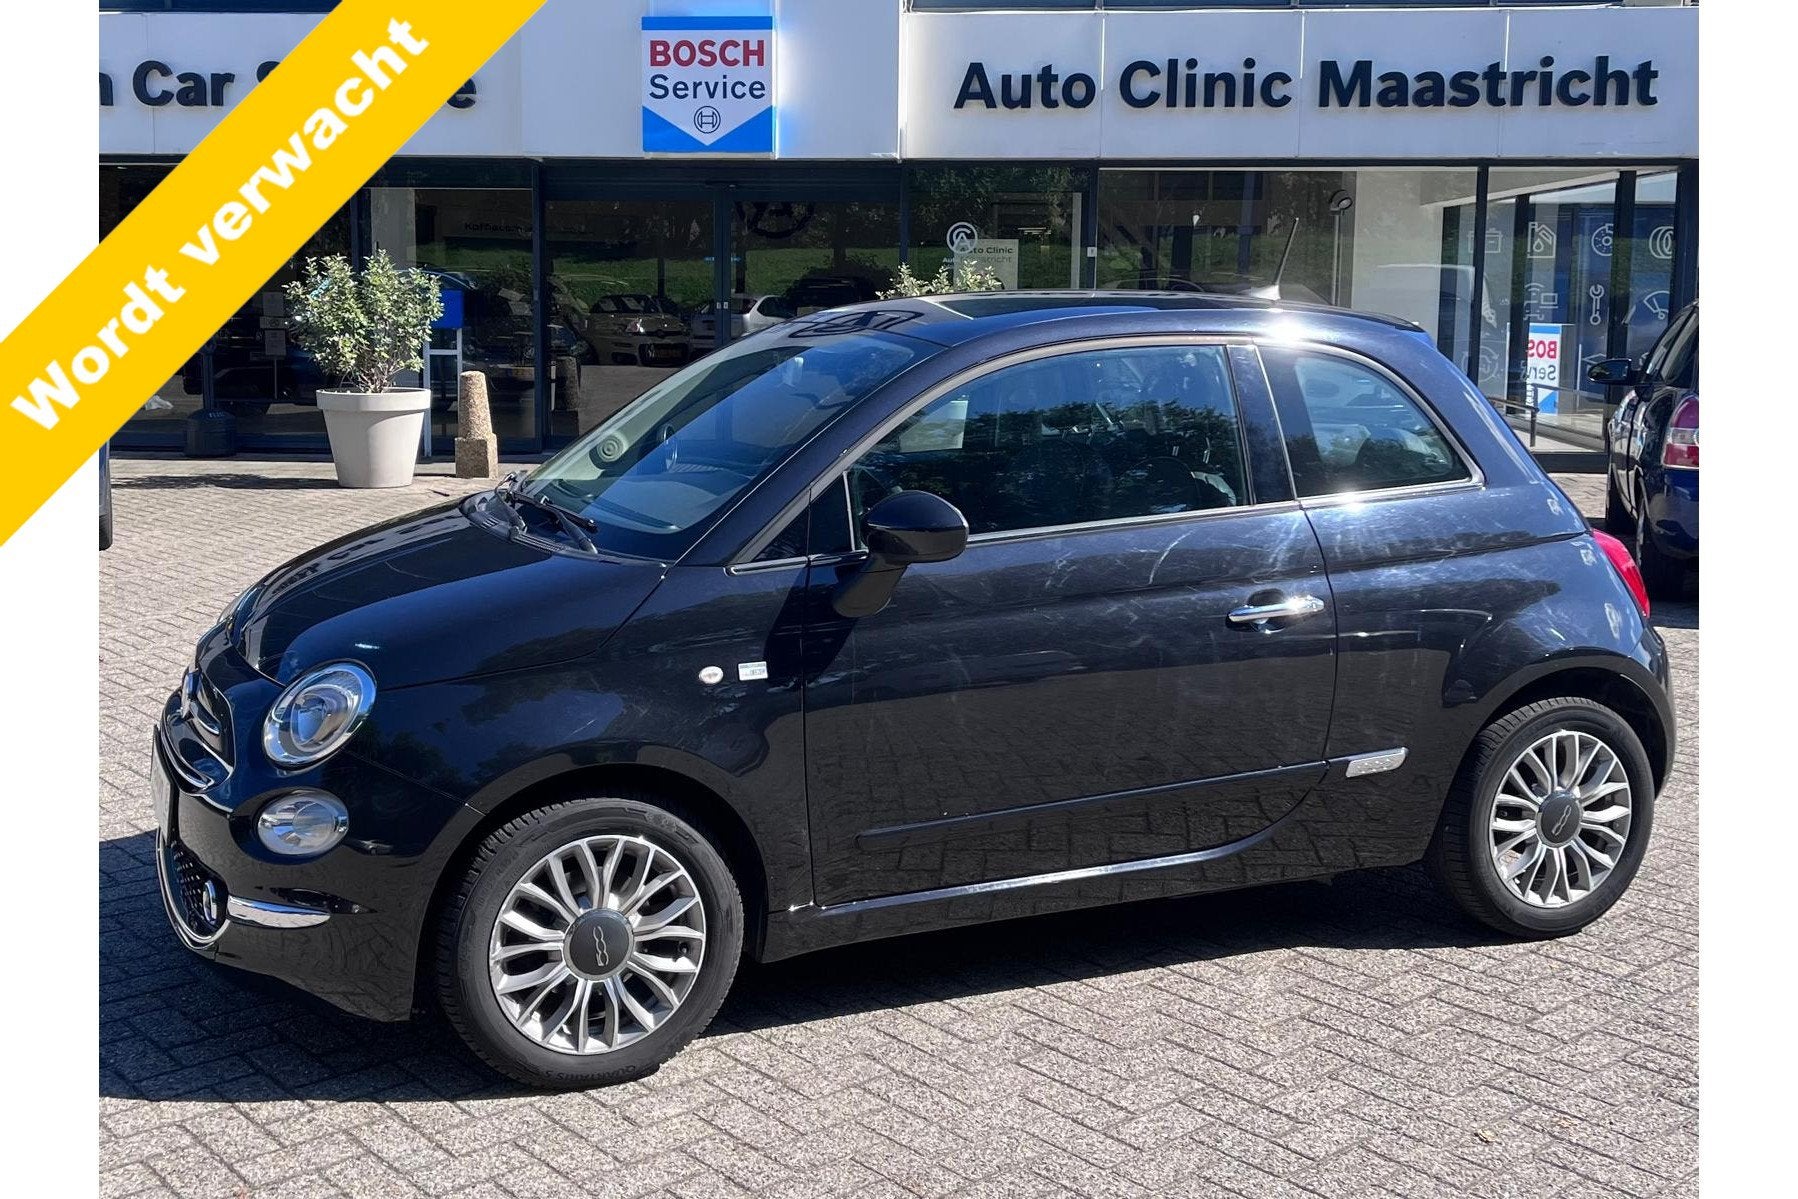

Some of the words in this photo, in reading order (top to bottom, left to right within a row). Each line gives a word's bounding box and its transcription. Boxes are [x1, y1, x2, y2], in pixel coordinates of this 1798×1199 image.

[649, 39, 765, 67] BOSCH
[132, 60, 236, 107] Car
[648, 73, 766, 100] Service
[953, 62, 1096, 110] Auto
[1119, 57, 1293, 109] Clinic
[1318, 55, 1659, 108] Maastricht
[985, 246, 1013, 254] Clinic
